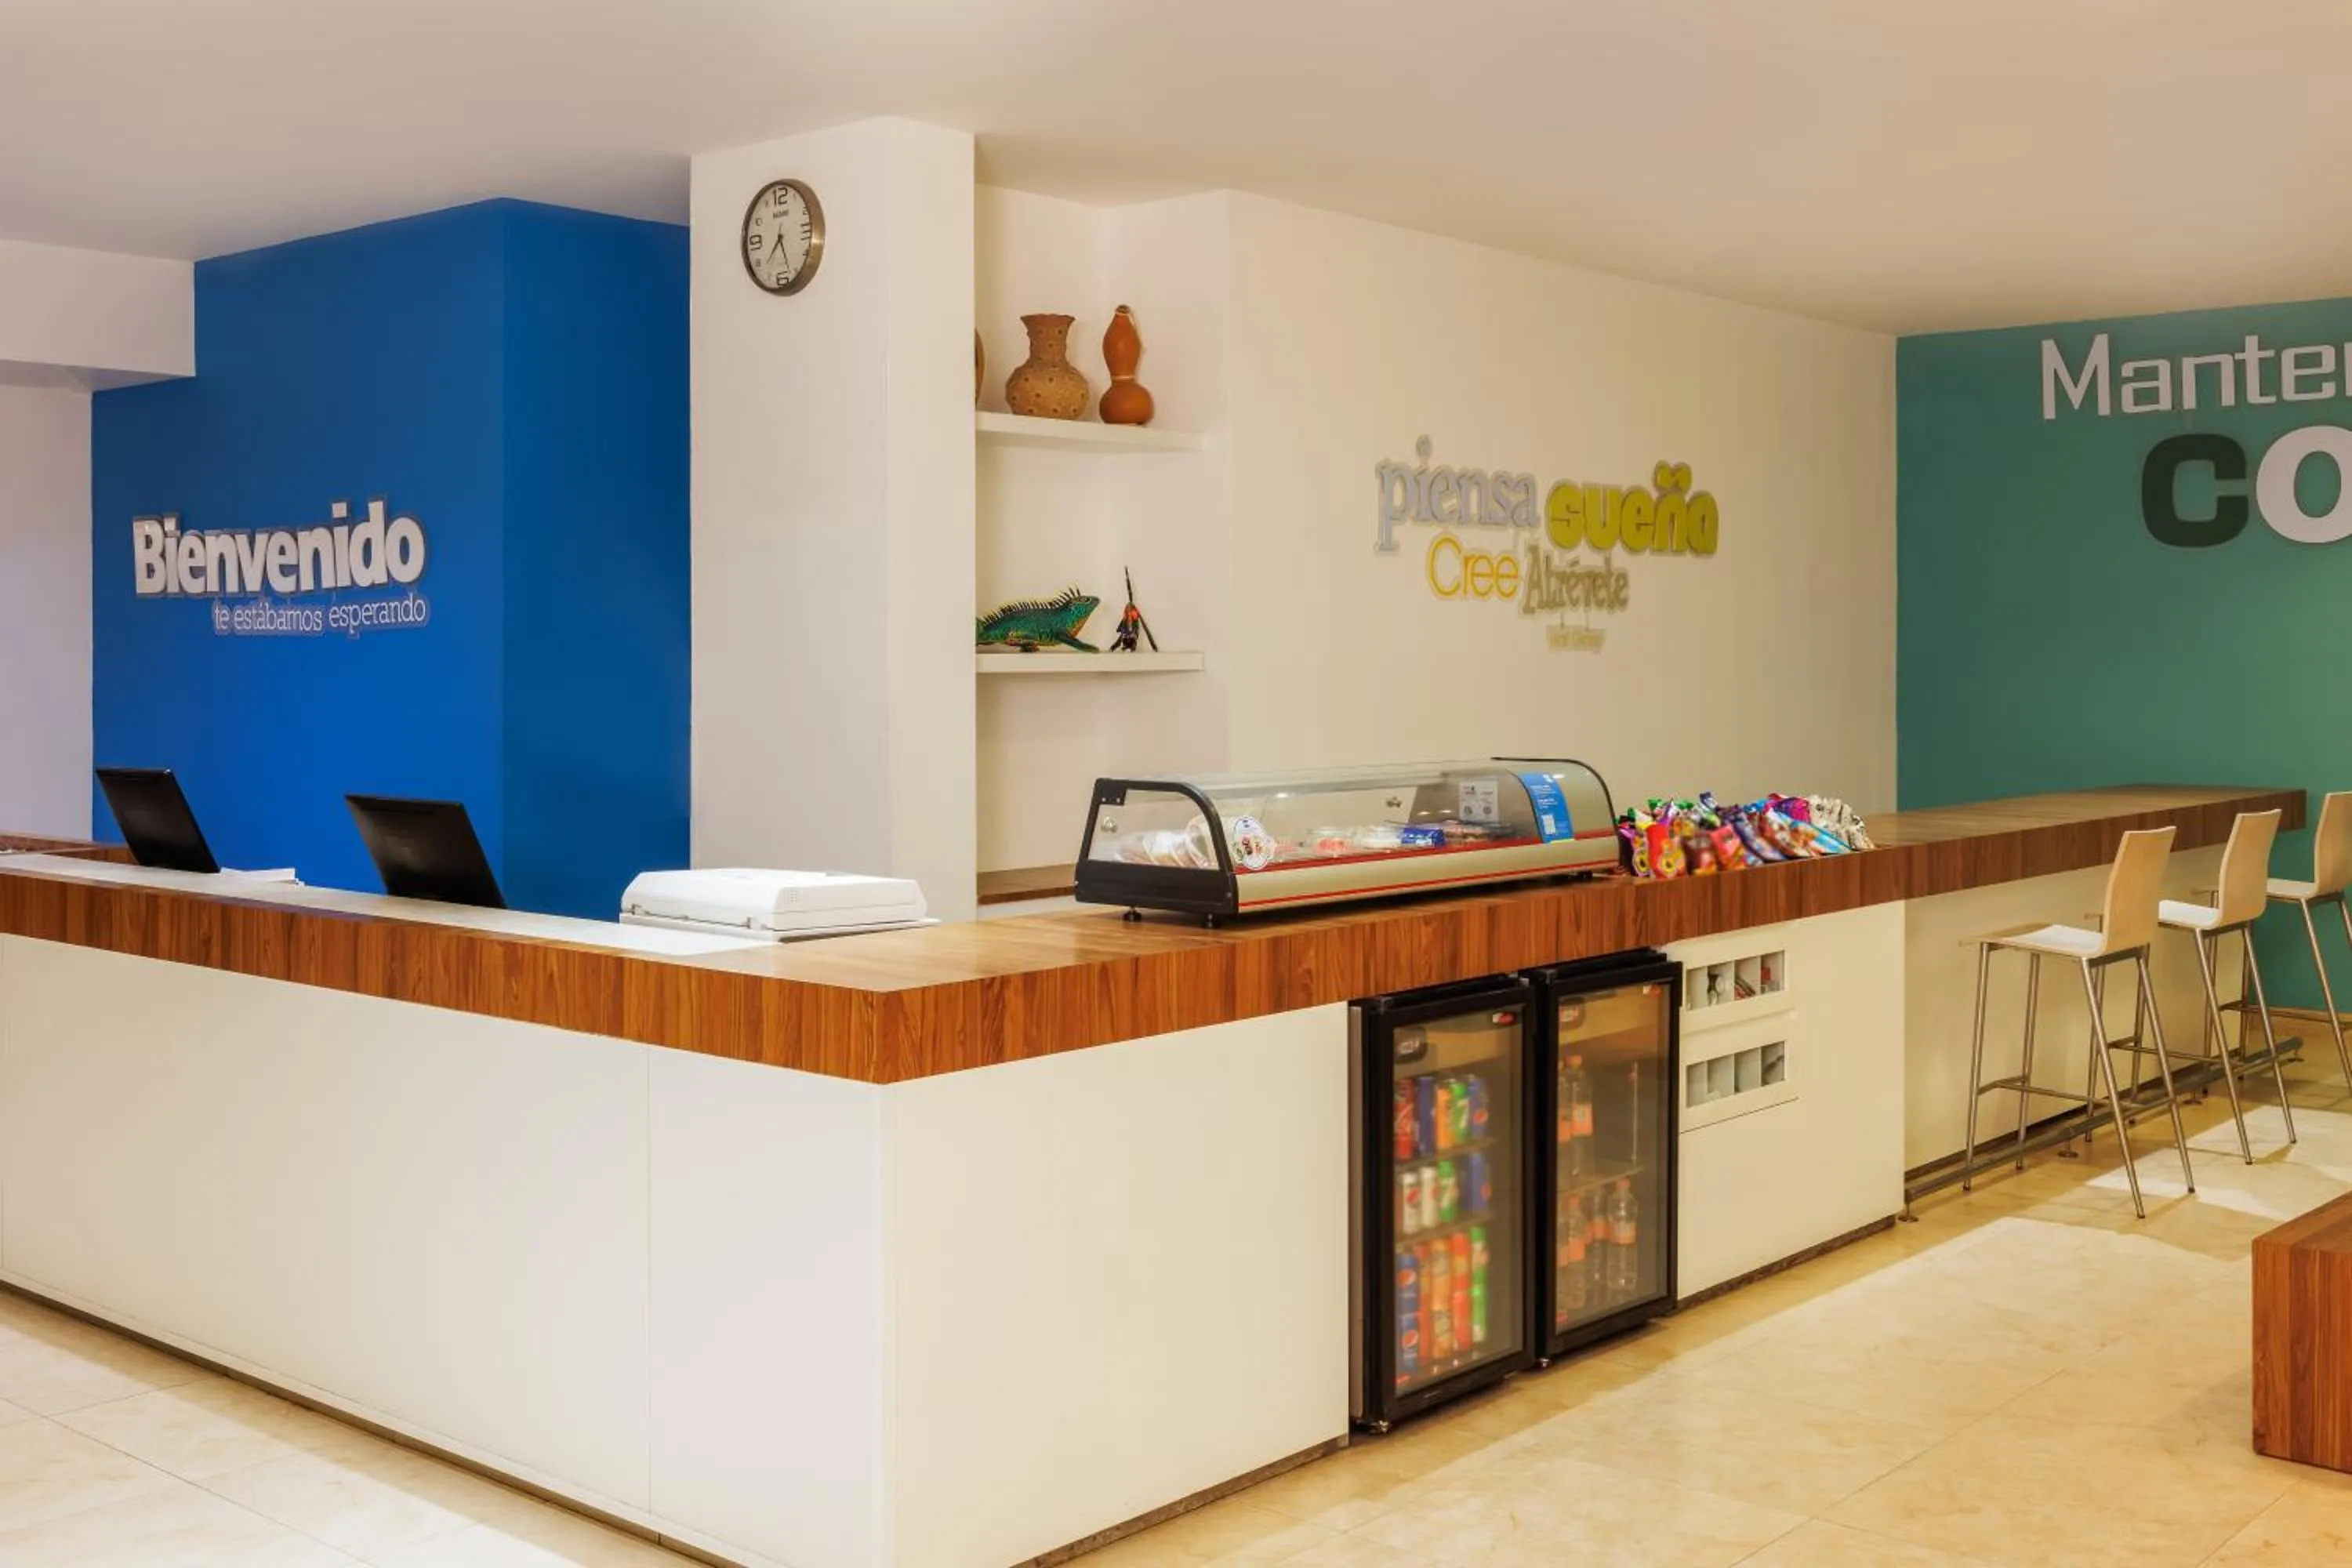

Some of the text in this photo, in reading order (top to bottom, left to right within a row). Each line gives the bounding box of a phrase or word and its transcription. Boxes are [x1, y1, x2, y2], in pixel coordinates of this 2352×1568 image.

[773, 187, 788, 205] 12
[750, 234, 763, 251] 9
[776, 271, 789, 285] 6
[2042, 333, 2352, 419] Mante
[1375, 434, 1540, 552] piensa
[132, 499, 426, 595] Bienvenido
[1428, 535, 1519, 599] Cree
[1523, 544, 1628, 614] Atrévete
[214, 593, 426, 635] te estábamos esperando
